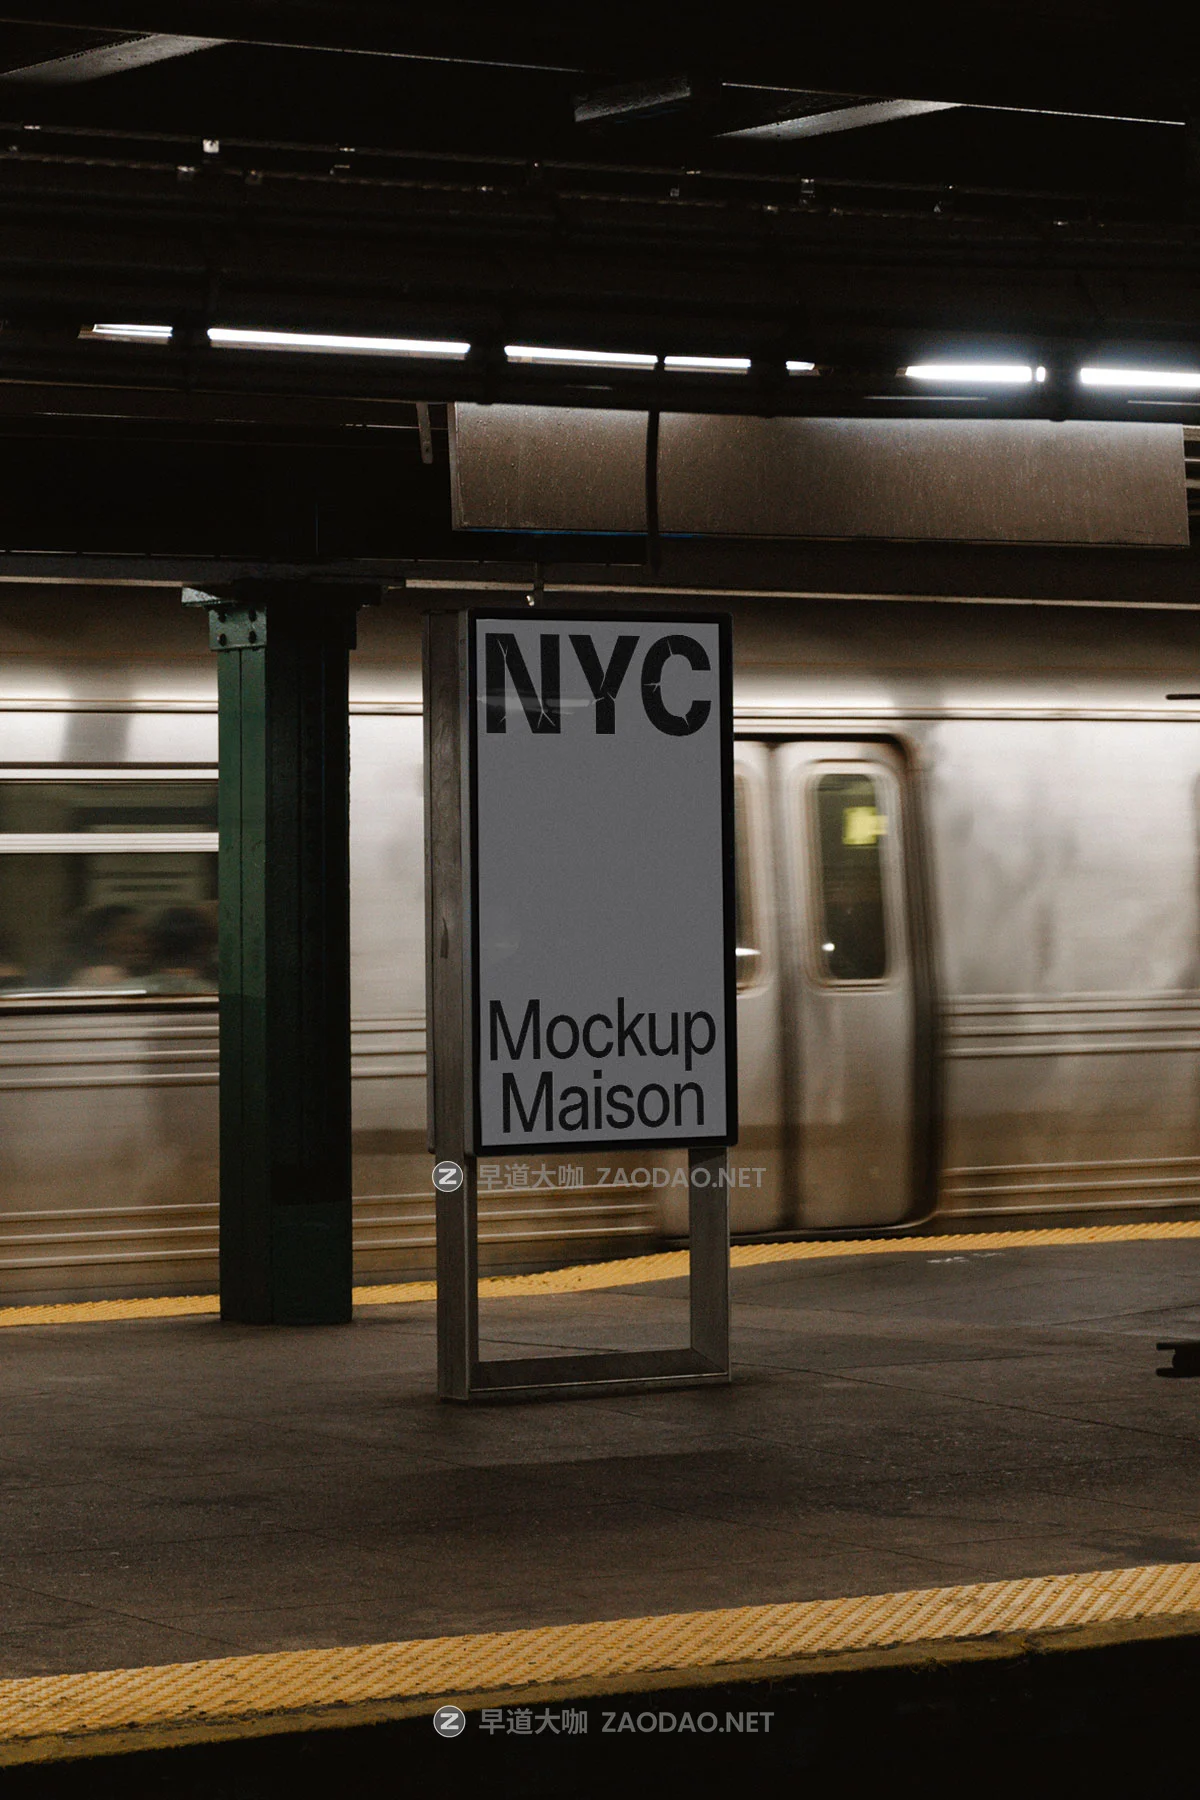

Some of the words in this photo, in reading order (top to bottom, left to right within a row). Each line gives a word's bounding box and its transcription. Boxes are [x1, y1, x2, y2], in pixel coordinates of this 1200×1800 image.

[485, 632, 712, 737] NYC
[489, 997, 716, 1071] Mockup
[502, 1069, 705, 1133] Maison
